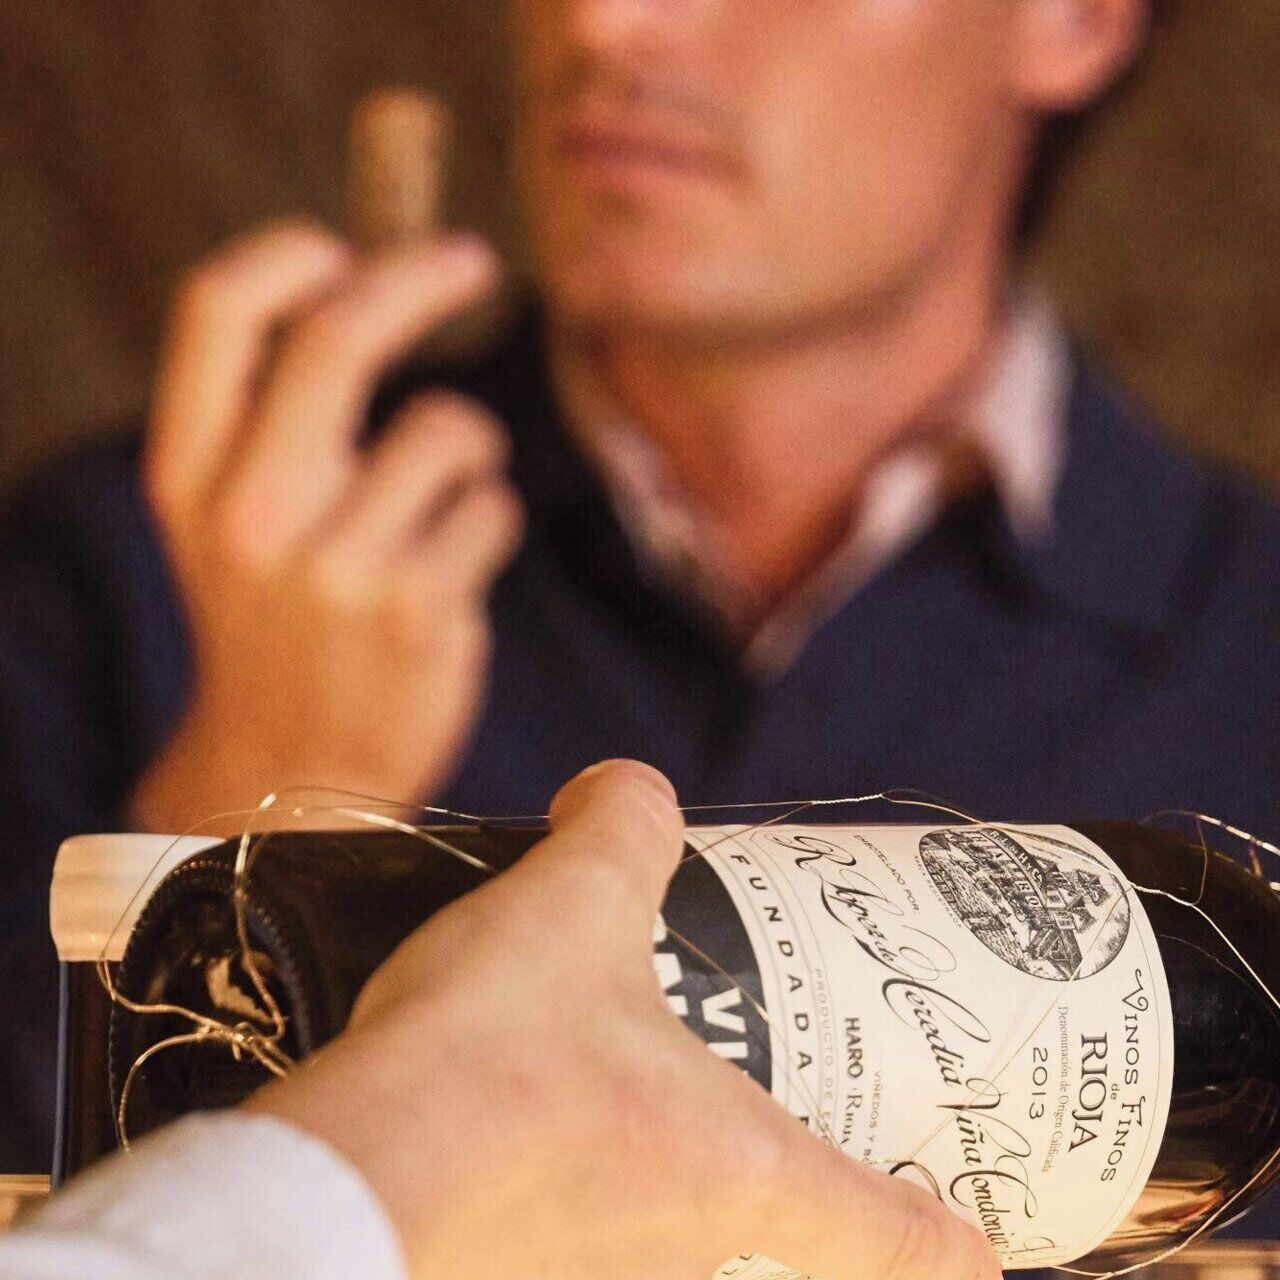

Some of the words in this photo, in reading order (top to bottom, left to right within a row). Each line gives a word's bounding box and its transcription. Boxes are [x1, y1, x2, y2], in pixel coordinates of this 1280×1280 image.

[729, 854, 812, 1070] FUNDADA
[845, 1017, 864, 1079] HARO
[853, 925, 992, 1088] Heredia
[936, 1077, 1033, 1167] Viña
[1058, 1006, 1070, 1077] Denominación
[1028, 1046, 1048, 1120] 2013
[1053, 1094, 1069, 1128] Origen
[1061, 1080, 1069, 1093] de
[1068, 1032, 1108, 1152] RIOJA
[1111, 1082, 1120, 1101] de
